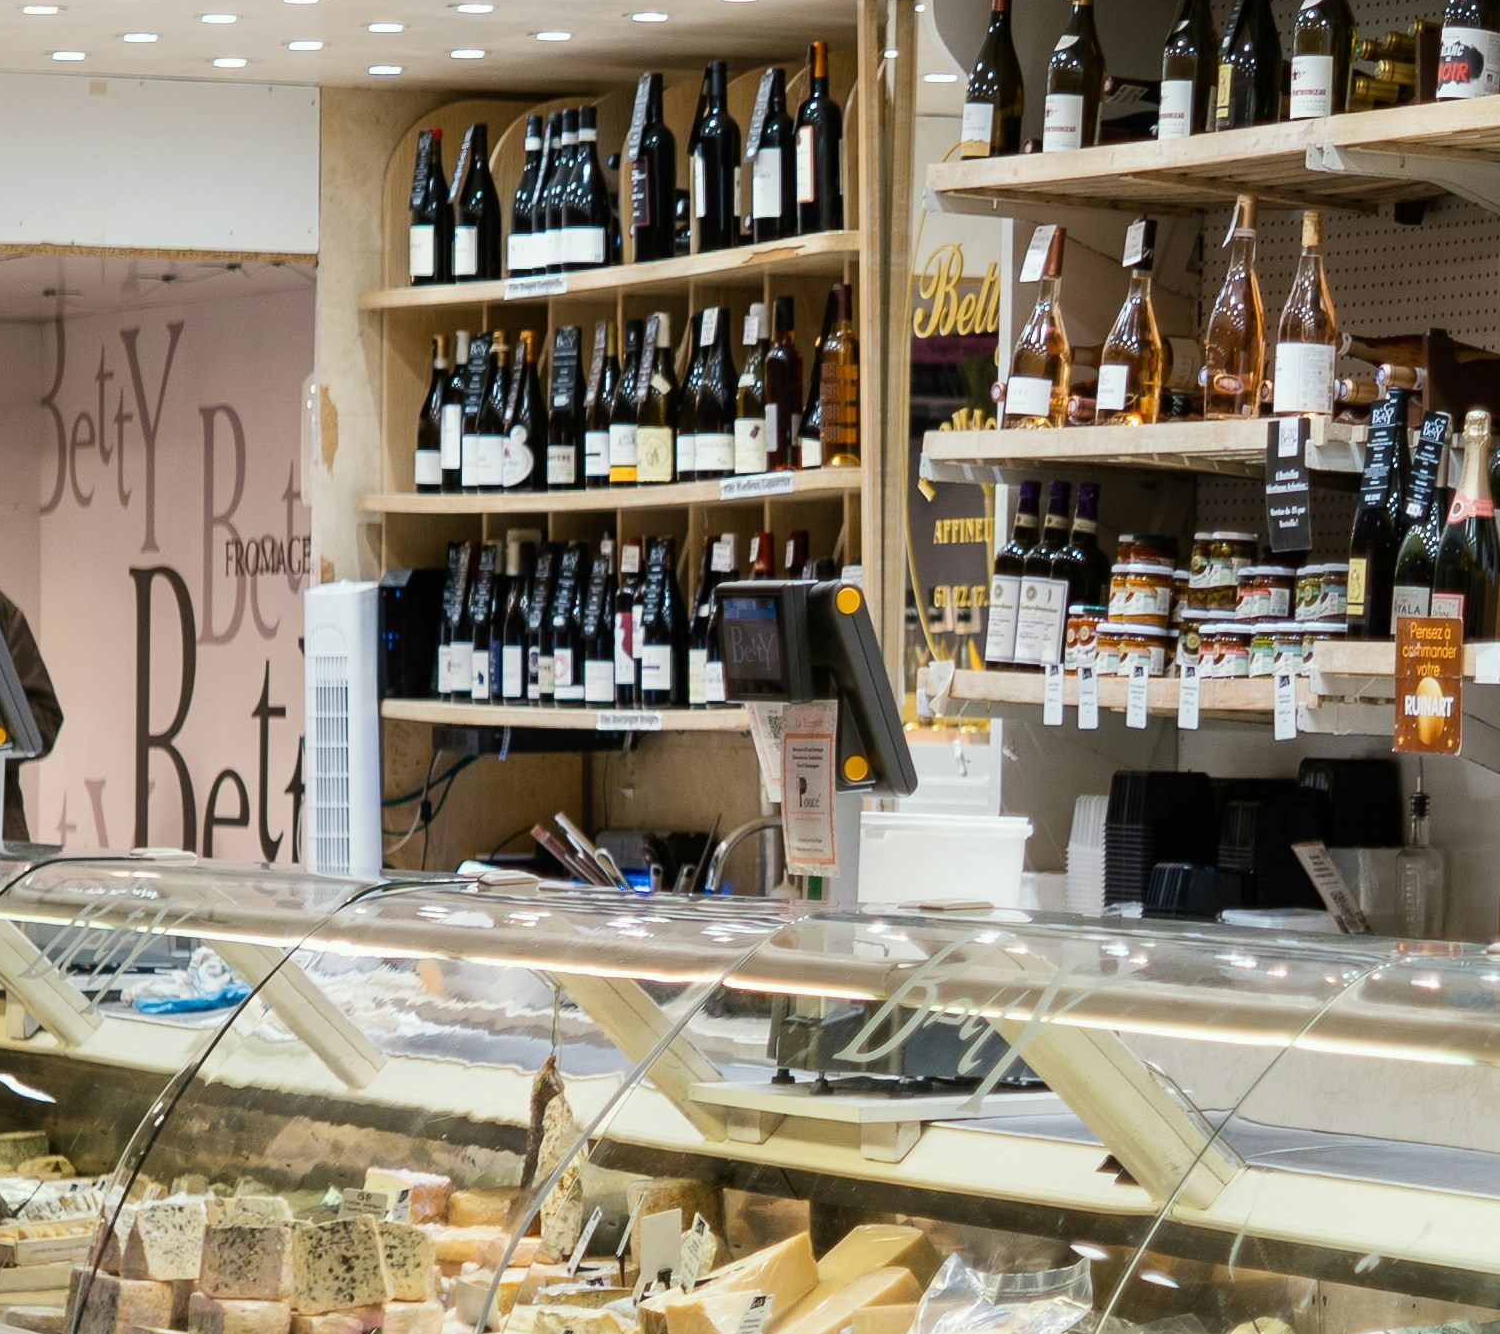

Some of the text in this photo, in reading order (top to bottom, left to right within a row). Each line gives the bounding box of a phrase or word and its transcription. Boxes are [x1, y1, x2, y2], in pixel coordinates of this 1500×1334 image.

[1410, 622, 1451, 640] Pensez à
[1402, 644, 1458, 661] commander
[1417, 663, 1441, 677] votre
[1404, 695, 1455, 718] RUINART
